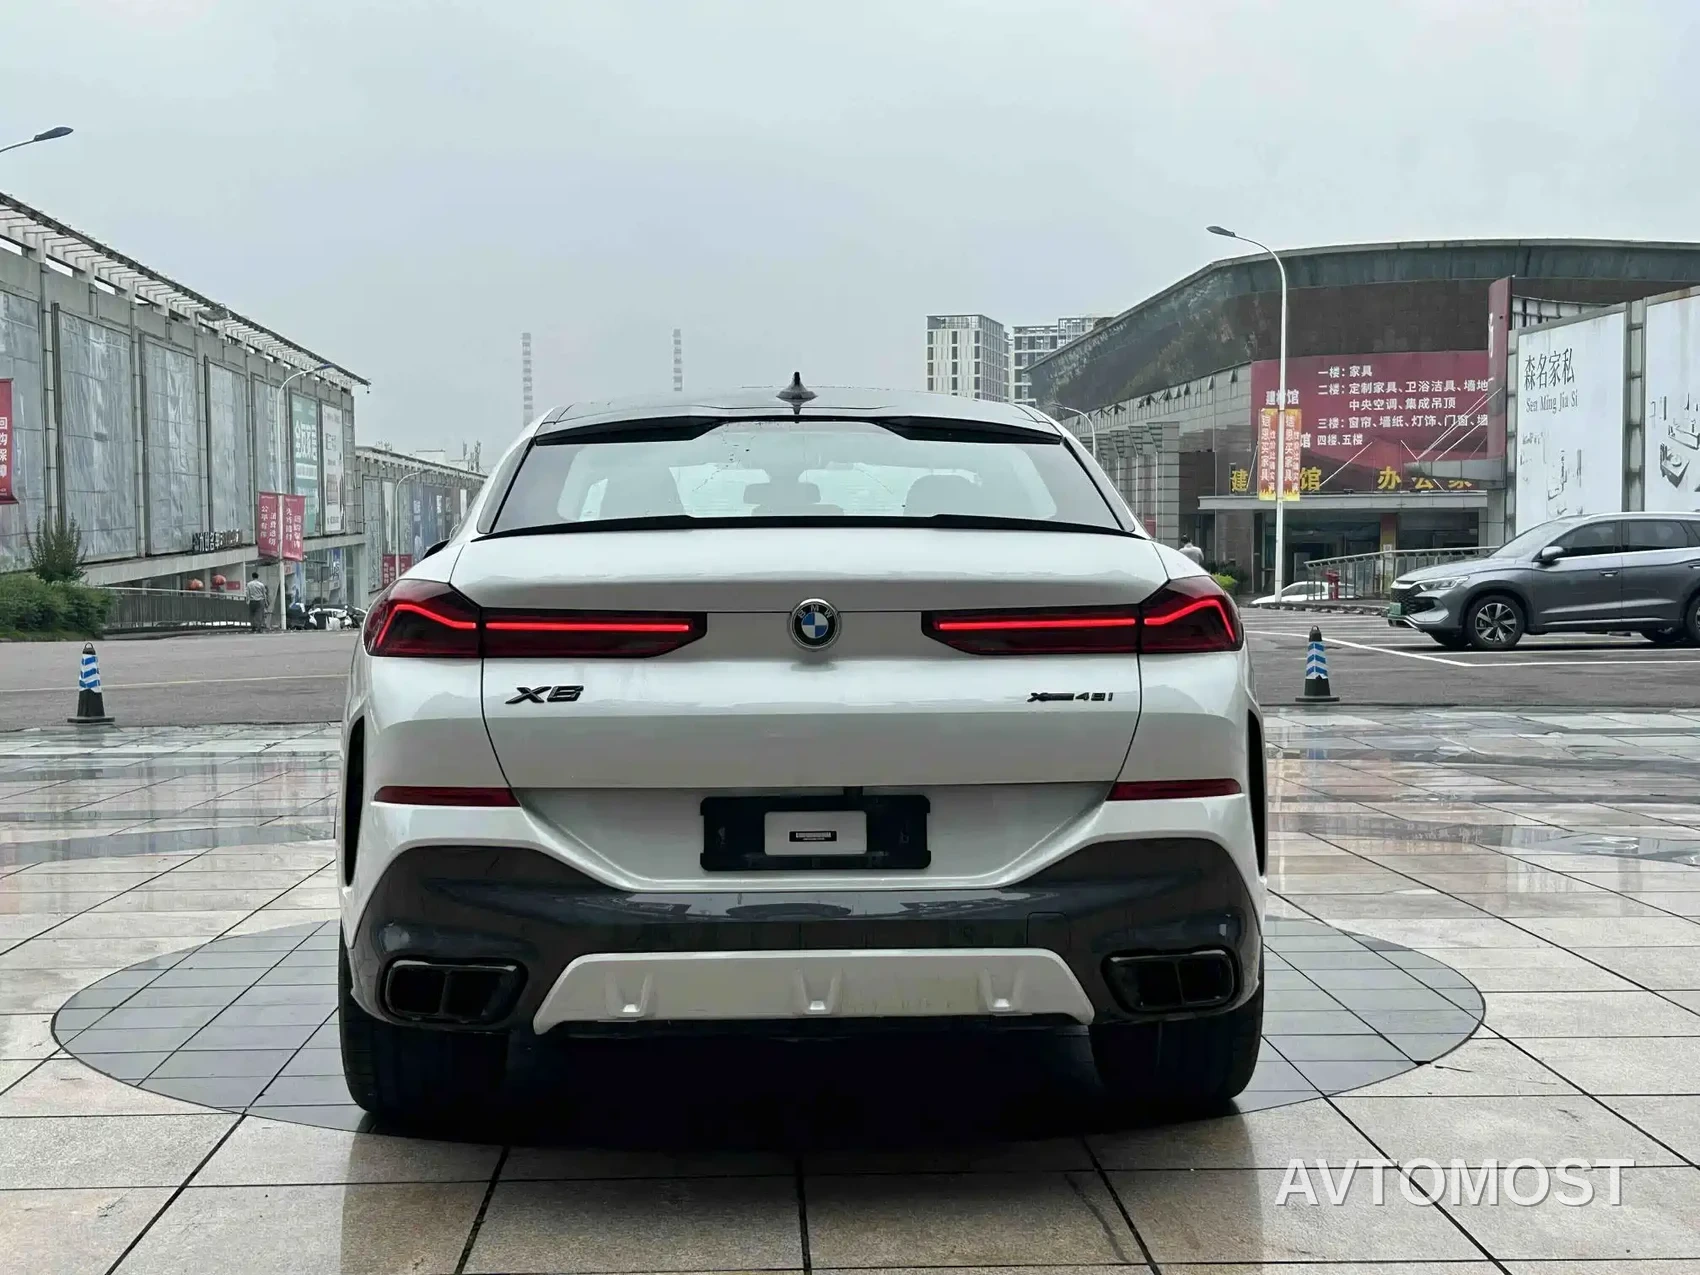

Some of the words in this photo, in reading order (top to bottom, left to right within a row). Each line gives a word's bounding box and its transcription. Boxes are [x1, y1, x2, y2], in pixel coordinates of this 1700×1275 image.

[1524, 347, 1575, 391] 森名家私
[1349, 396, 1456, 411] 中央空调、集成吊顶
[1525, 397, 1538, 413] Sen
[1540, 394, 1557, 414] Ming
[1558, 391, 1569, 412] Jia
[1571, 389, 1578, 408] Si
[1317, 433, 1364, 446] 四楼、五楼
[797, 604, 833, 619] BMW
